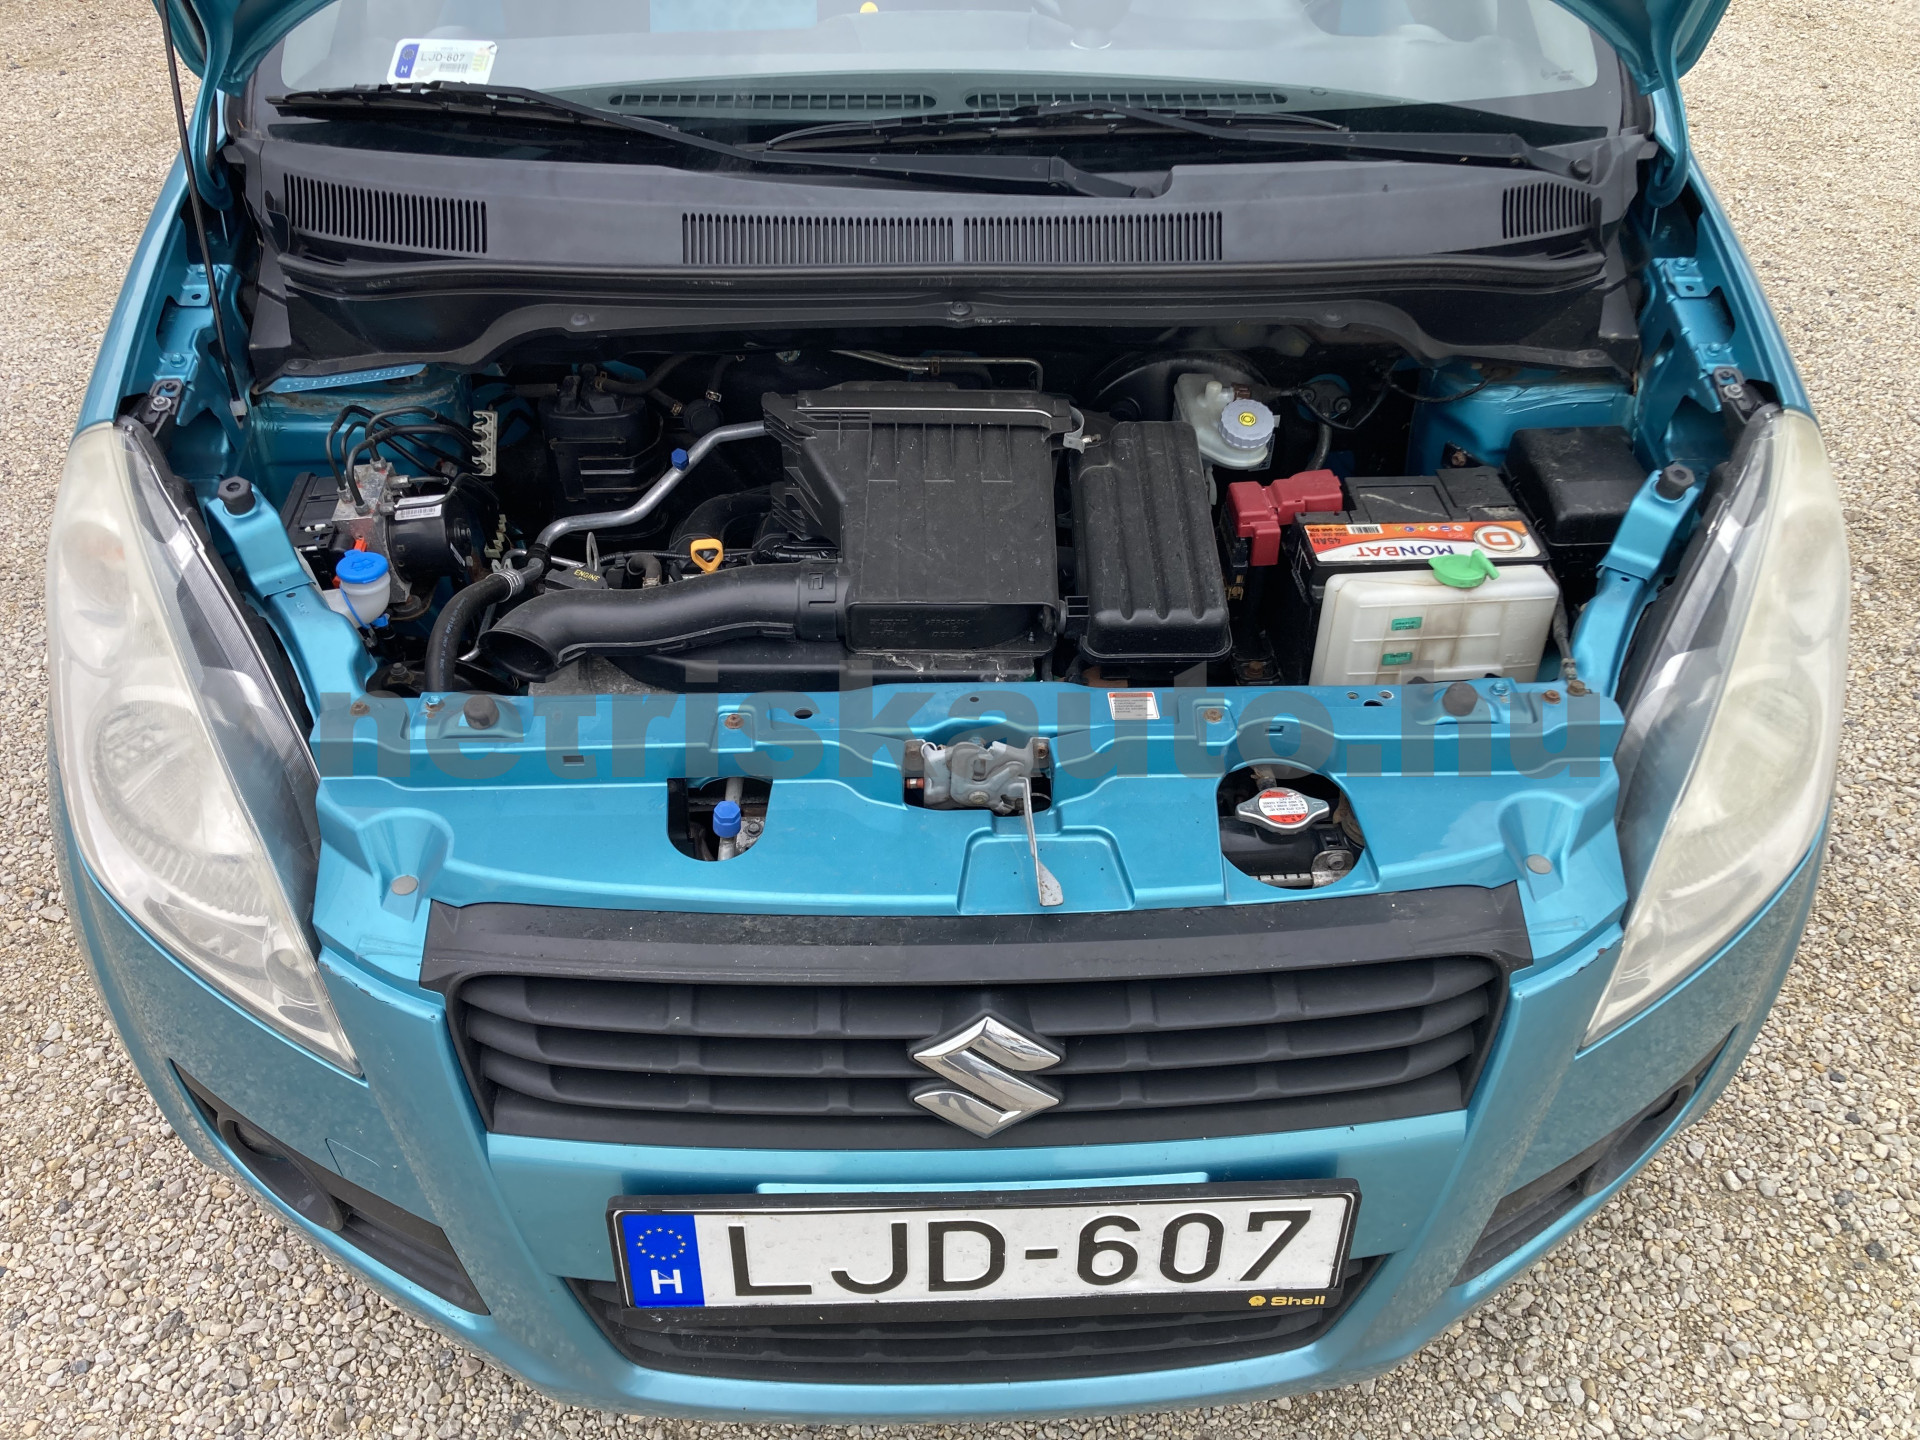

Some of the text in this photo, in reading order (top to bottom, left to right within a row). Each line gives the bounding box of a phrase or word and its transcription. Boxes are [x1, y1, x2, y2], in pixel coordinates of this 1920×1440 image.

[421, 52, 465, 62] LJD-607
[1312, 537, 1341, 545] 45Ah
[1356, 545, 1455, 557] MONBAT
[574, 569, 600, 582] ENGINE
[727, 1209, 1312, 1296] LJD-607
[650, 1268, 683, 1295] H
[1270, 1295, 1326, 1306] Shell
